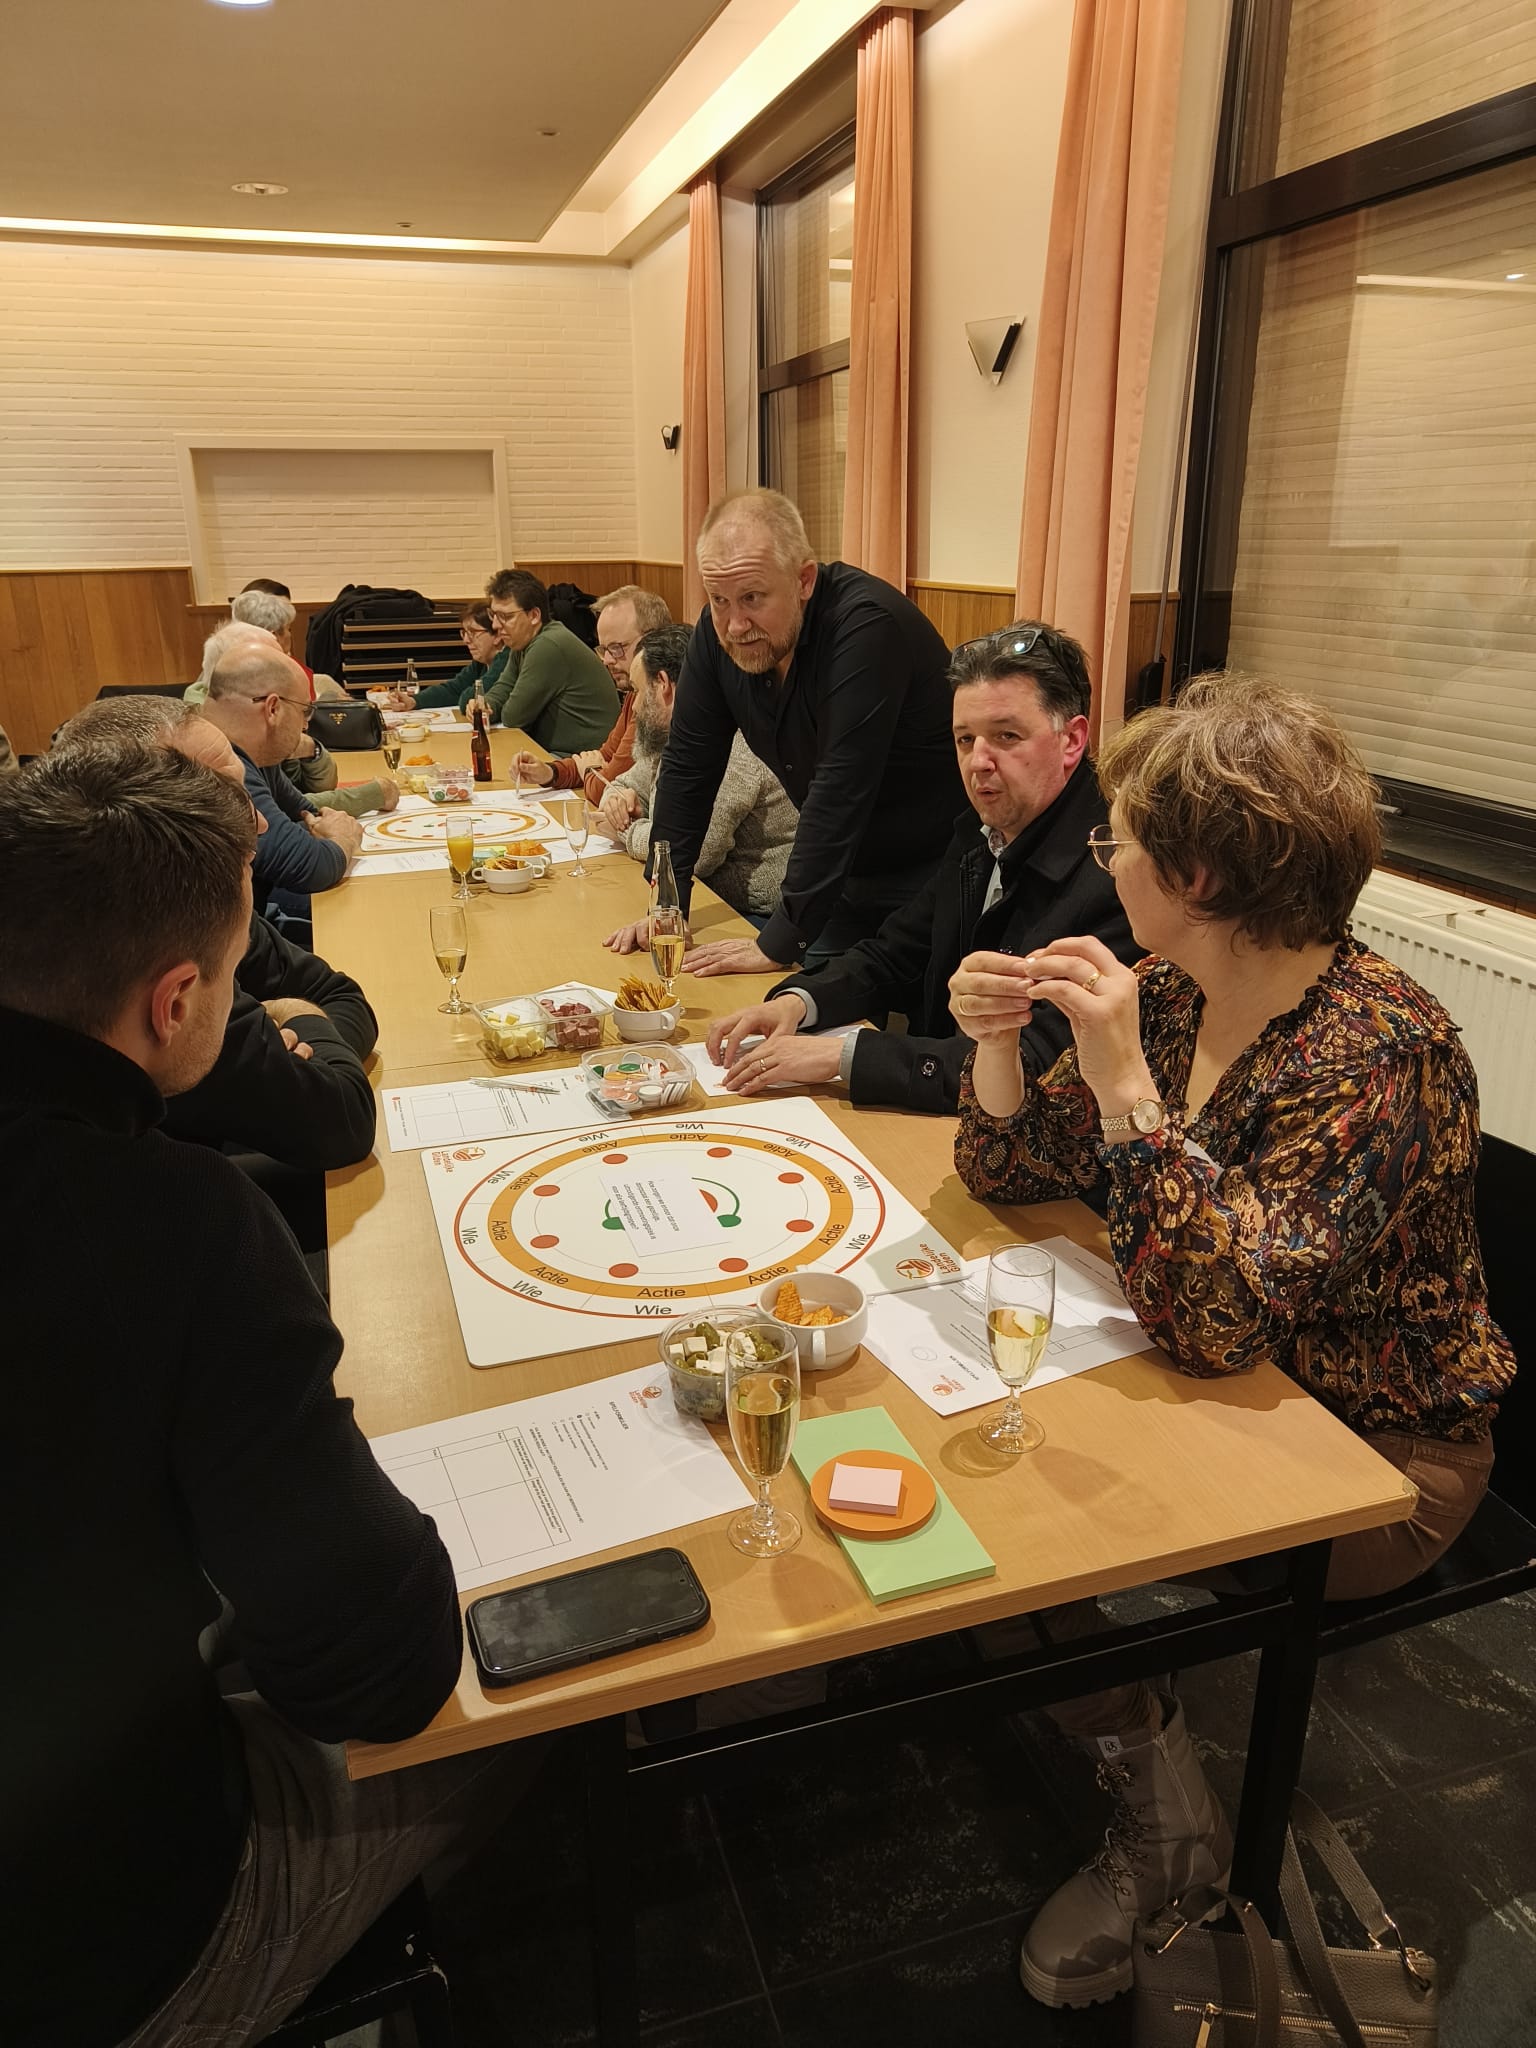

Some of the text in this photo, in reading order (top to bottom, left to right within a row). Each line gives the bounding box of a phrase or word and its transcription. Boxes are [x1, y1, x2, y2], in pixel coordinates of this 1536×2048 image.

[578, 1132, 609, 1142] Wie
[669, 1133, 709, 1141] Actie
[785, 1136, 812, 1150] Wie
[582, 1140, 618, 1153] Actie
[763, 1143, 798, 1158] Actie
[487, 1170, 515, 1185] Wie
[509, 1171, 539, 1191] Actie
[824, 1175, 847, 1194] Actie
[853, 1174, 872, 1190] Wie
[461, 1227, 478, 1245] Wie
[492, 1220, 508, 1241] Actie
[818, 1223, 845, 1246] Actie
[845, 1233, 871, 1250] Wie
[919, 1243, 951, 1274] Landelijke
[939, 1252, 961, 1272] Gilden
[530, 1266, 569, 1285] Actie
[748, 1265, 789, 1285] Actie
[512, 1280, 543, 1298] Wie
[636, 1287, 686, 1298] Actie
[634, 1304, 672, 1315] Wie
